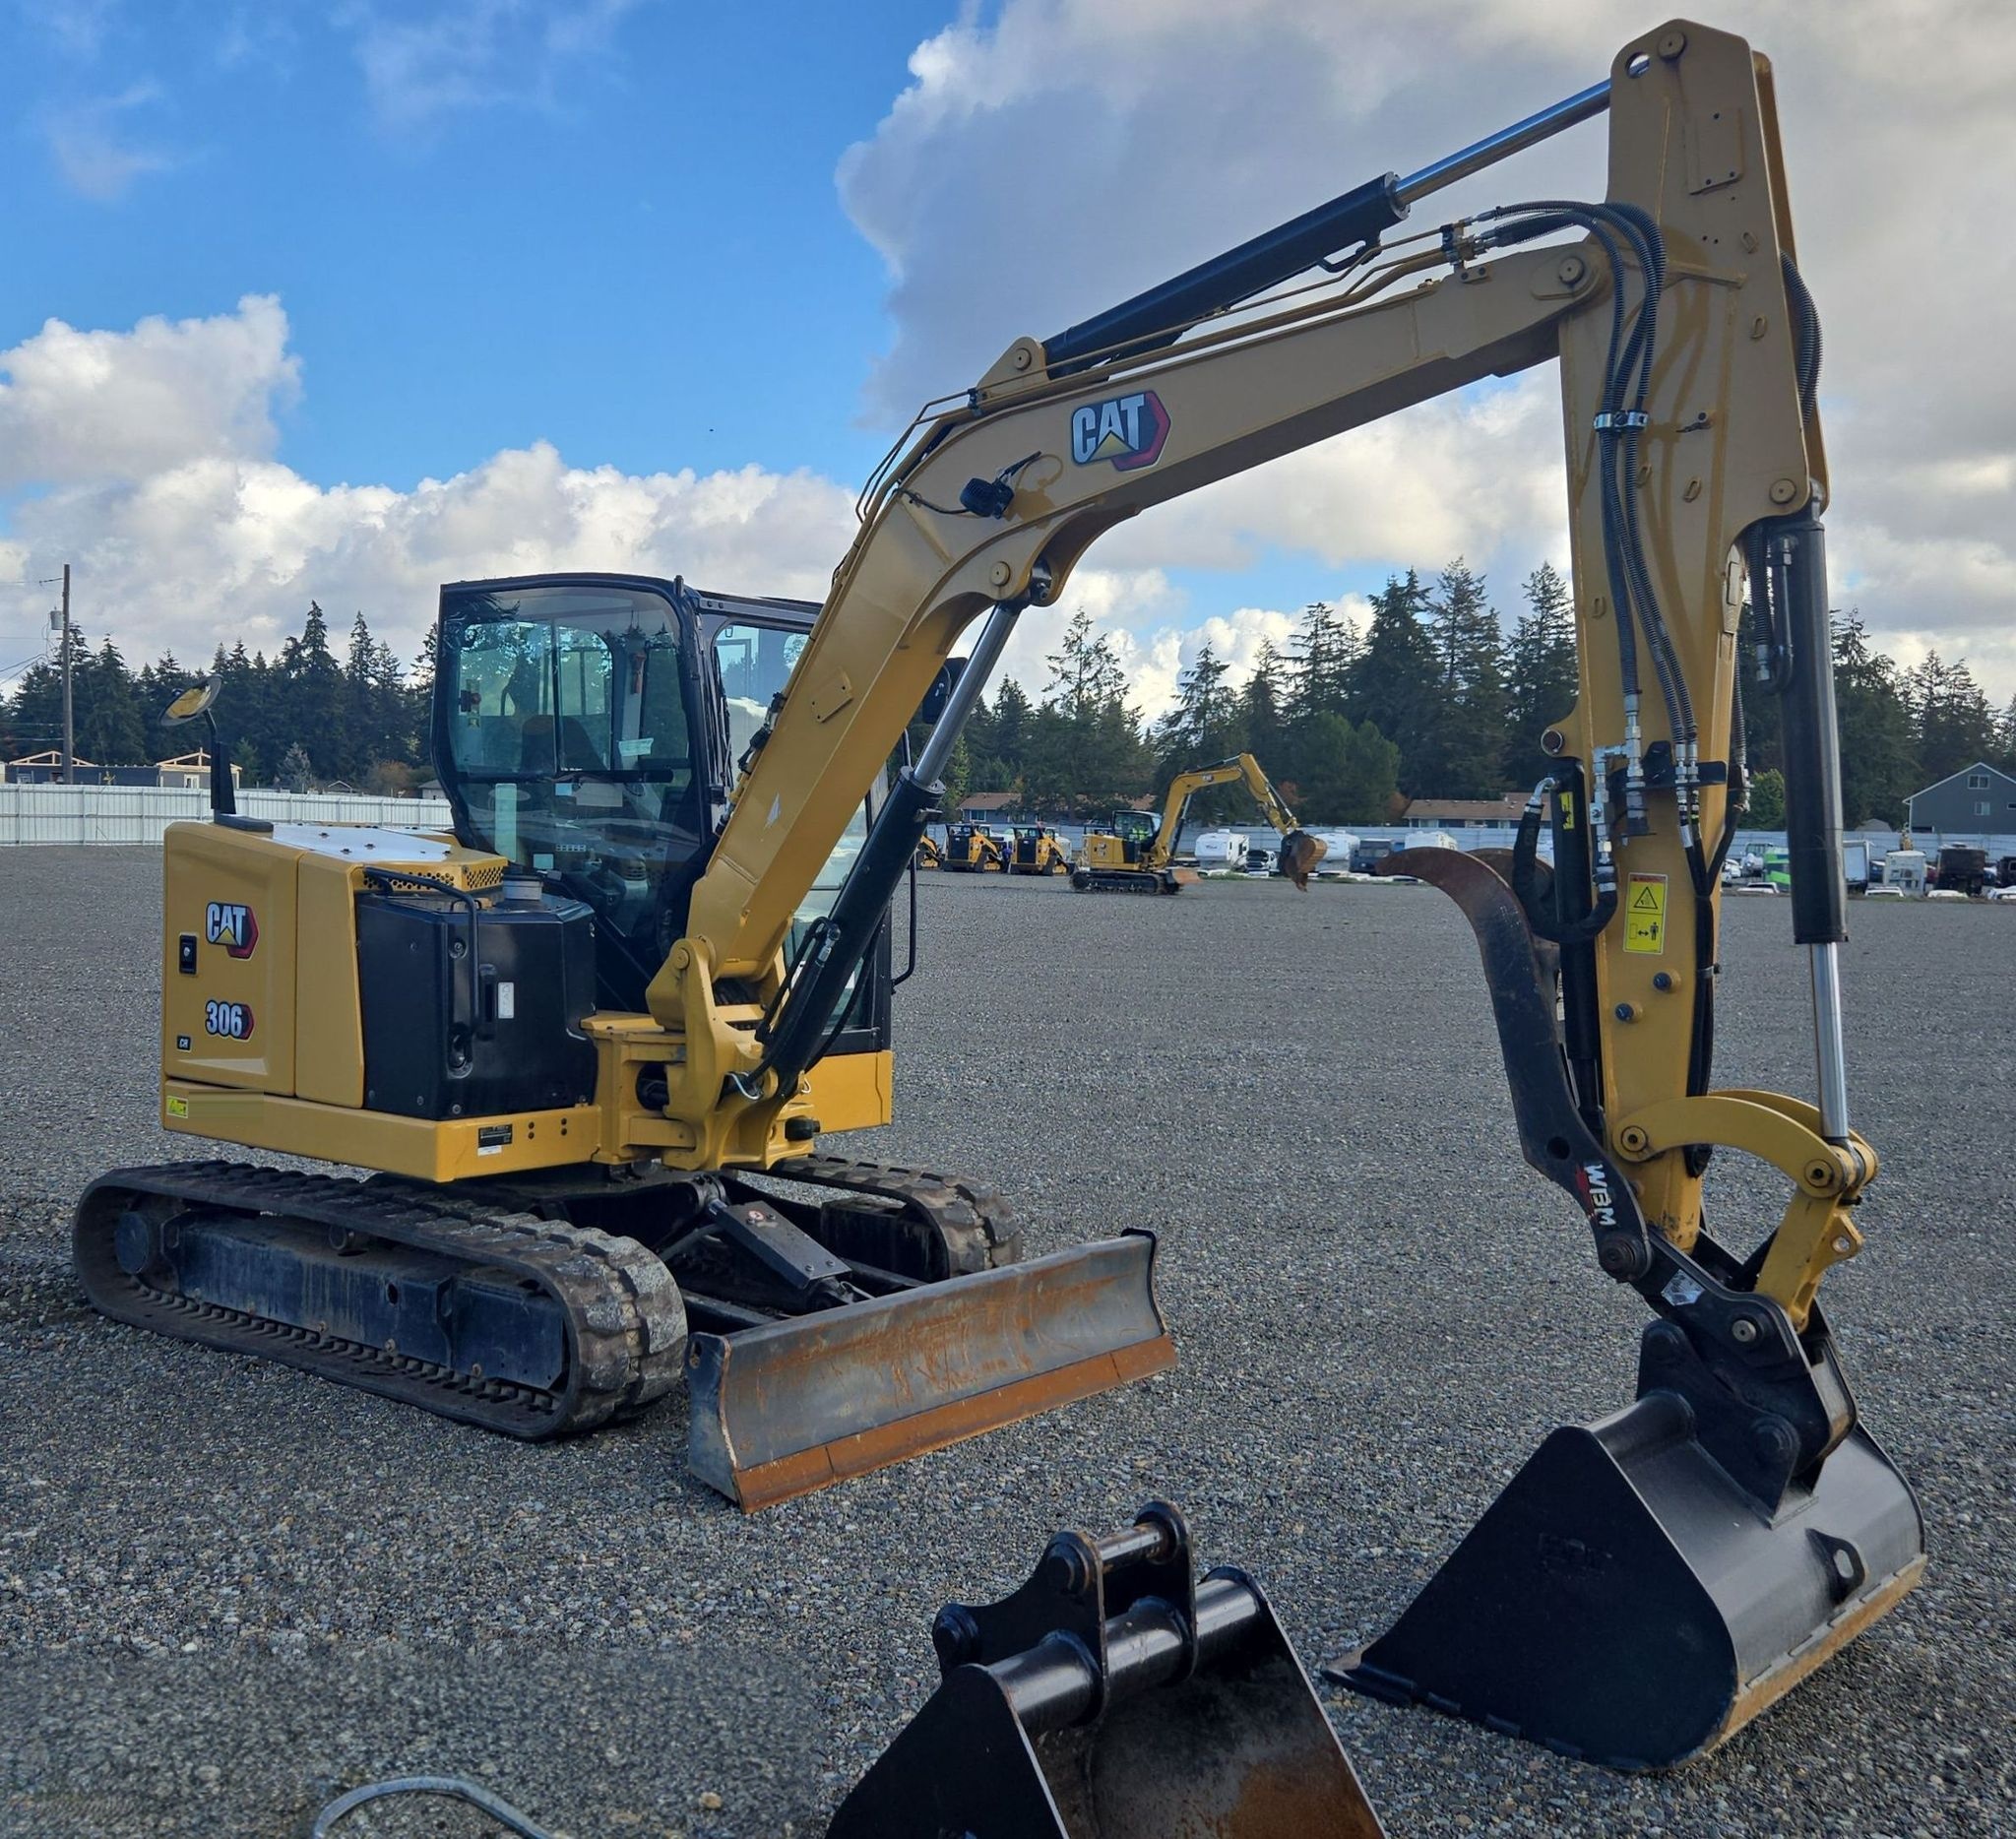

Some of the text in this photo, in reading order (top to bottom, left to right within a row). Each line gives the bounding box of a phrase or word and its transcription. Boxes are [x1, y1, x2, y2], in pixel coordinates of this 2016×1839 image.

[1072, 394, 1145, 464] CAT
[207, 904, 246, 946] CAT
[206, 1001, 242, 1037] 306
[1584, 1164, 1616, 1226] WBM
